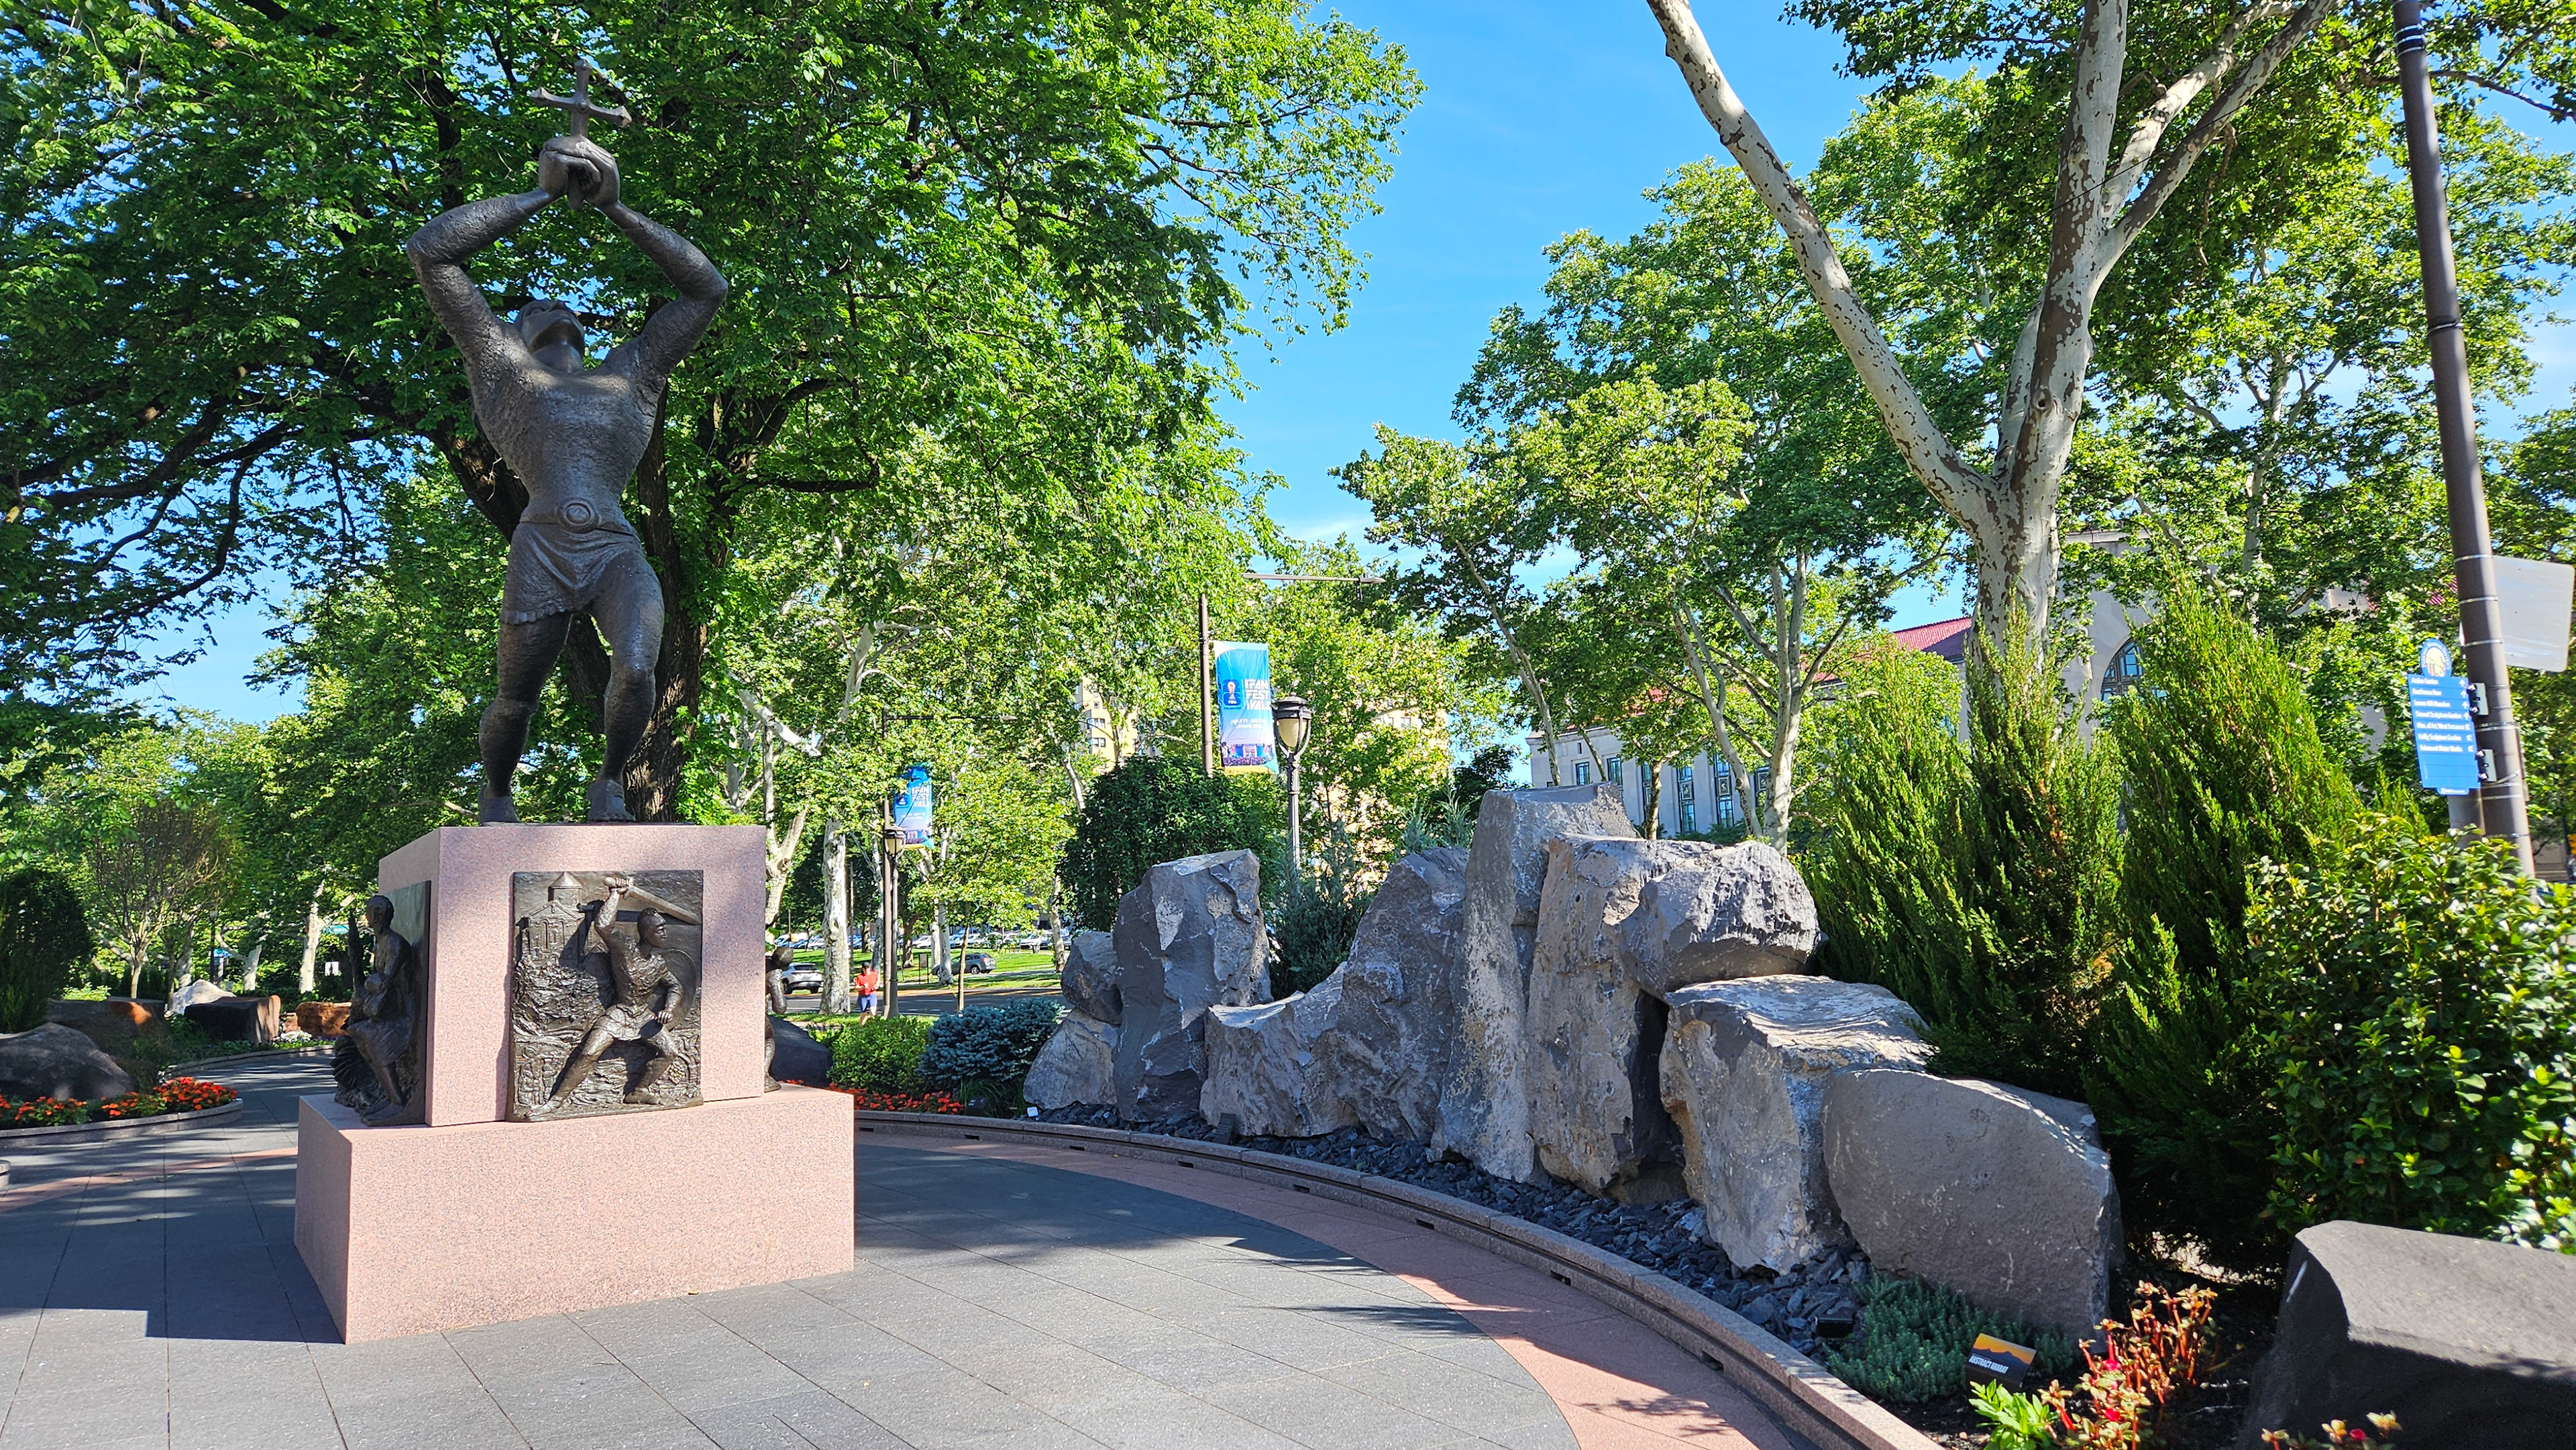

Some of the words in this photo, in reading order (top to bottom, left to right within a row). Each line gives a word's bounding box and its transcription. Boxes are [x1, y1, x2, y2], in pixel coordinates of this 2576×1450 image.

[1248, 679, 1269, 689] FAN
[1246, 689, 1270, 700] FEST
[1968, 1355, 1992, 1369] ABSTRACT
